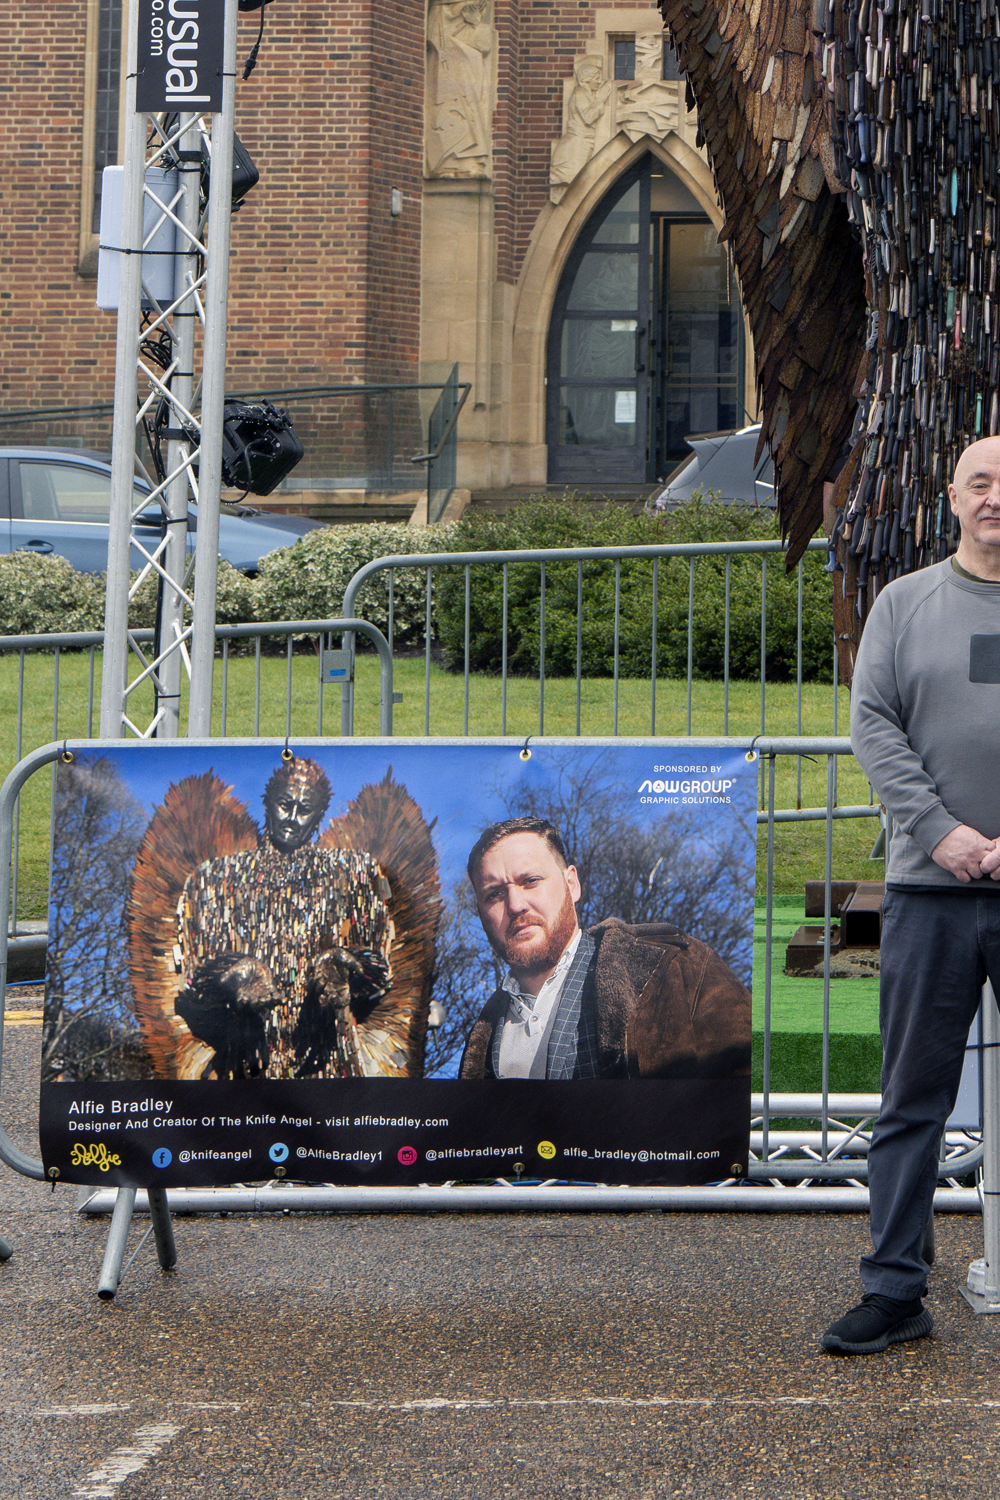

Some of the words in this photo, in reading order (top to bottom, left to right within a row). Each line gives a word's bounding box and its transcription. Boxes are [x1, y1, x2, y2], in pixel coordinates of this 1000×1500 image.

[653, 765, 708, 773] SPONSORED
[710, 765, 722, 773] BY
[640, 796, 680, 804] GRAPHIC
[682, 796, 732, 804] SOLUTIONS
[68, 1100, 105, 1114] Alfie
[111, 1098, 174, 1113] Bradley
[68, 1120, 122, 1132] Designer
[125, 1118, 149, 1130] And
[153, 1117, 198, 1128] Creator
[201, 1116, 215, 1126] Of
[219, 1116, 242, 1127] The
[245, 1114, 277, 1125] Knife
[280, 1115, 312, 1127] Angel
[325, 1116, 350, 1127] visit
[353, 1115, 449, 1129] alfiebradley.com
[178, 1149, 253, 1163] @knifeangel
[296, 1146, 383, 1163] @AlfieBradley1
[425, 1145, 523, 1161] @alfiebradleyart
[563, 1147, 721, 1162] alfie_bradley@hotmail.com
